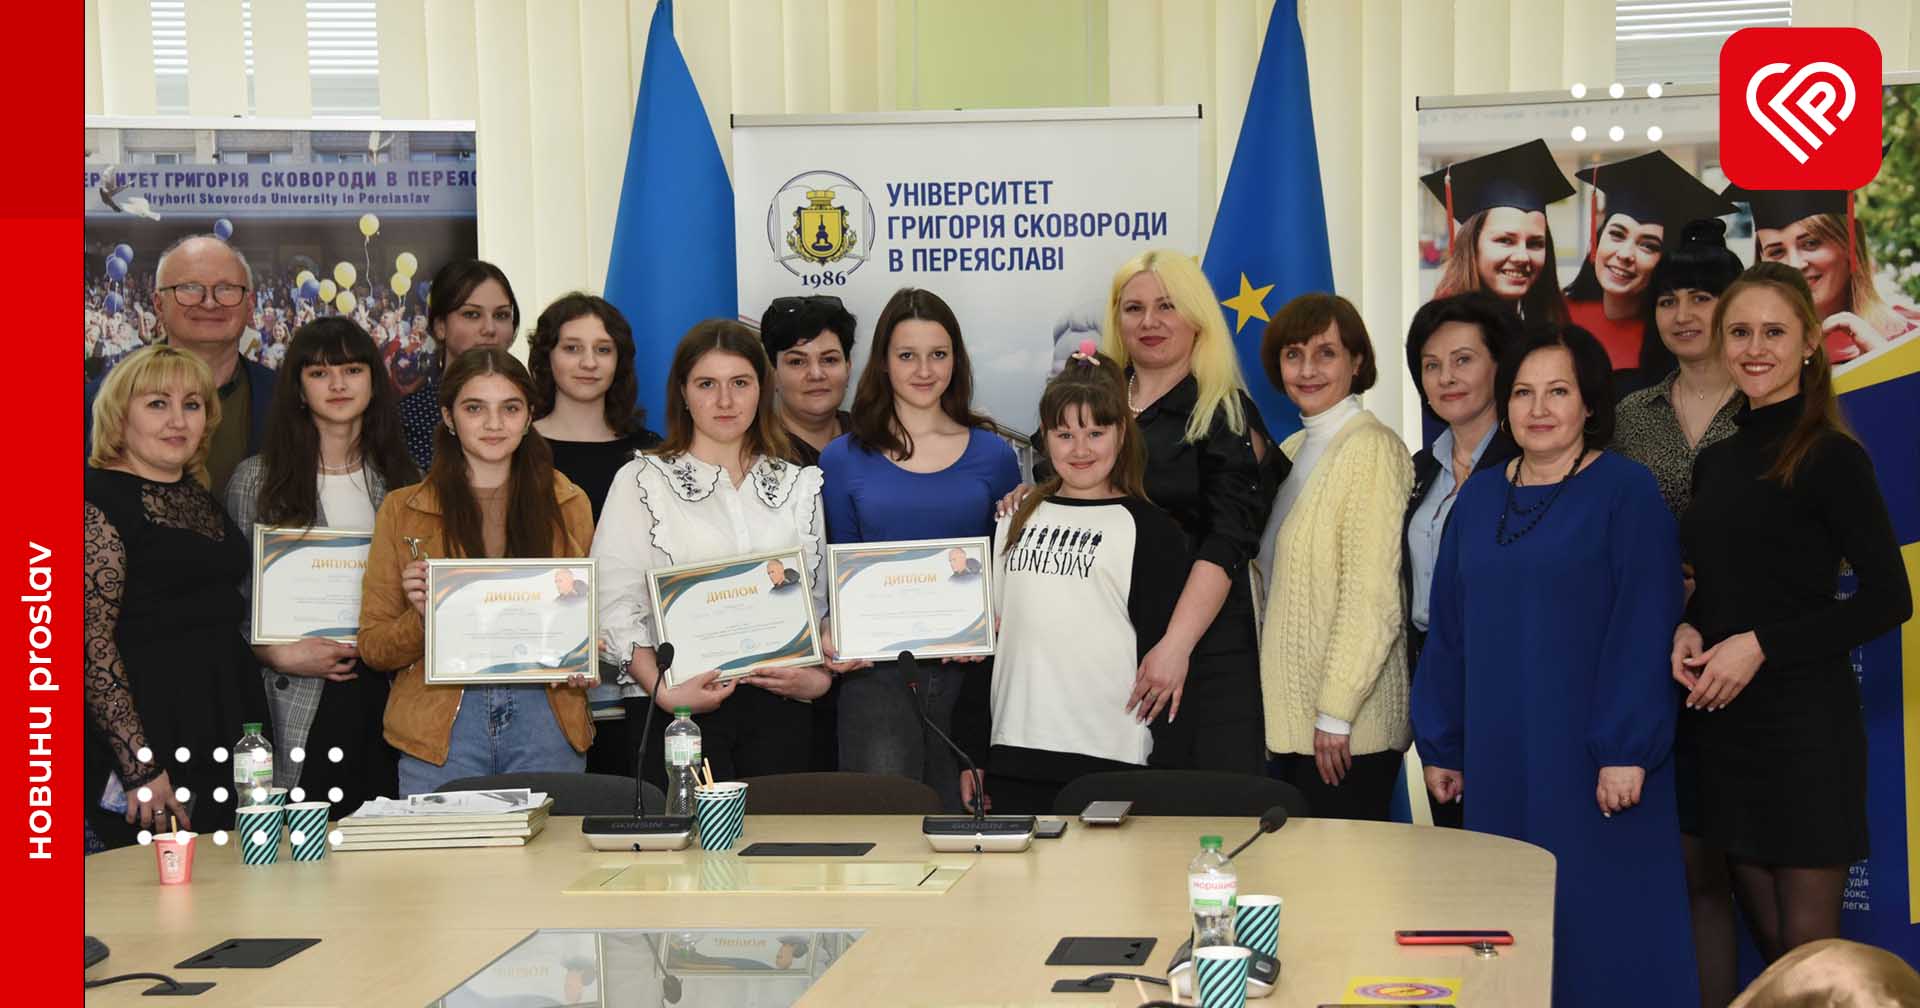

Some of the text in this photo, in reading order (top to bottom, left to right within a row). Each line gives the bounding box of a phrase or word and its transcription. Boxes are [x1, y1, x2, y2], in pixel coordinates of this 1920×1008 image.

[85, 172, 158, 188] РИТЕТ
[165, 171, 249, 188] ГРИГОРІЯ
[261, 171, 376, 190] СКОВОРОДИ
[387, 171, 397, 187] В
[199, 192, 266, 205] Skovoroda
[271, 193, 338, 207] University
[343, 193, 354, 204] in
[359, 193, 431, 205] Pereiaslav
[886, 180, 1054, 207] УНІВЕРСИТЕТ
[887, 211, 1168, 241] ГРИГОРІЯ СКОВОРОДИ
[889, 246, 1064, 272] В ПЕРЕЯСЛАВІ
[801, 272, 847, 289] 1986
[311, 557, 368, 570] ДИПЛОМ
[883, 573, 938, 587] ДИПЛОМ
[483, 590, 542, 605] ДИПЛОМ
[706, 584, 759, 605] ДИПЛОМ
